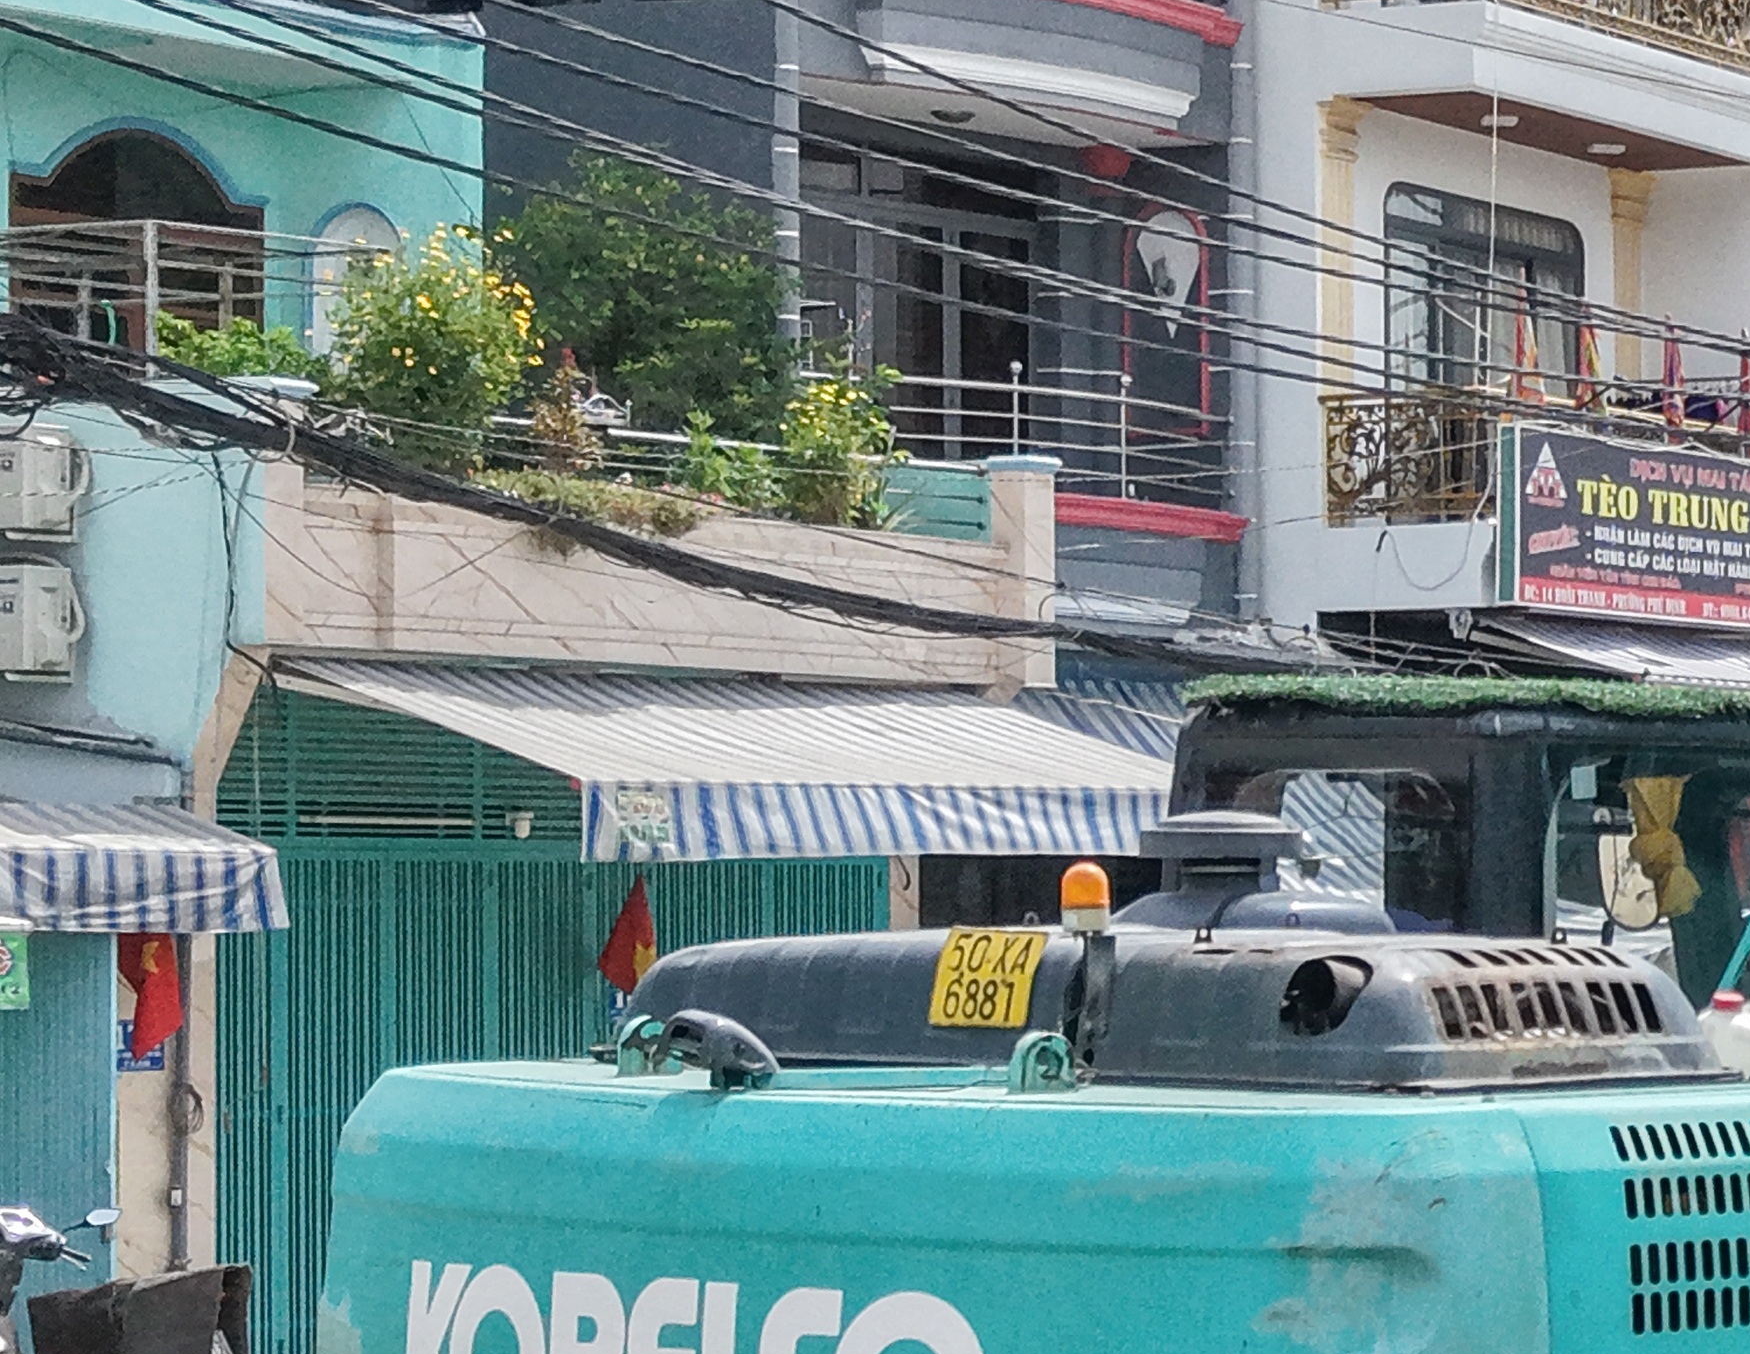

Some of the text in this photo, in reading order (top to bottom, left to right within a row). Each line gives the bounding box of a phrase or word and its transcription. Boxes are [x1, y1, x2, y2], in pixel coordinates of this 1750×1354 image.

[1669, 463, 1694, 489] VỤ
[1576, 474, 1639, 521] TÈO
[1648, 489, 1750, 534] TRUNG
[1627, 527, 1651, 547] LÀM
[1653, 531, 1675, 550] CÁC
[1594, 547, 1625, 567] CUNG
[1627, 549, 1650, 569] CẤP
[1652, 552, 1675, 572] CÁC
